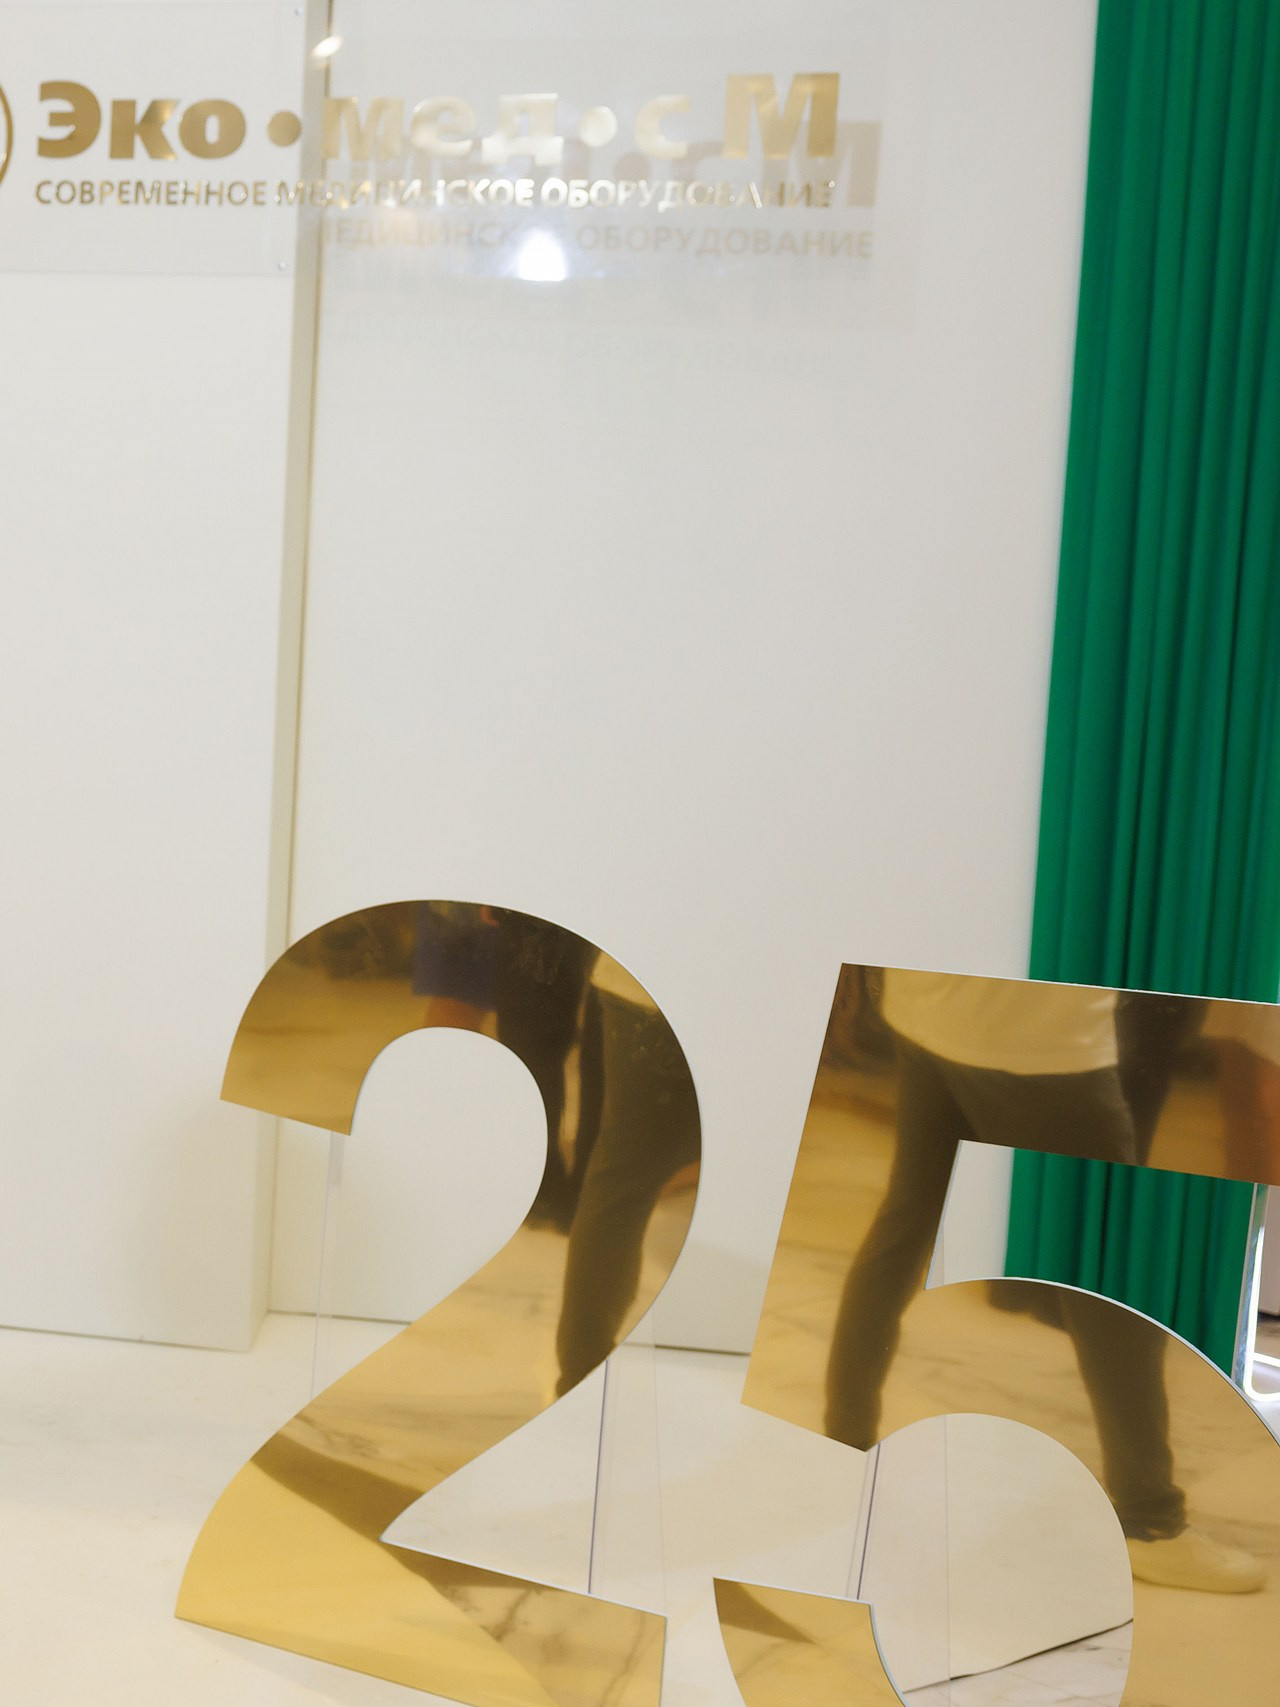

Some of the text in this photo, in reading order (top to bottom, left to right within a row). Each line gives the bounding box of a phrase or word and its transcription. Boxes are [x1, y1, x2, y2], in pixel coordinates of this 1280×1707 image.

[36, 80, 247, 160] Эко
[35, 180, 267, 206] СОВРЕМЕННОЕ
[540, 177, 834, 212] ОБОРУДОВАНИЕ
[174, 898, 1280, 1707] 25
